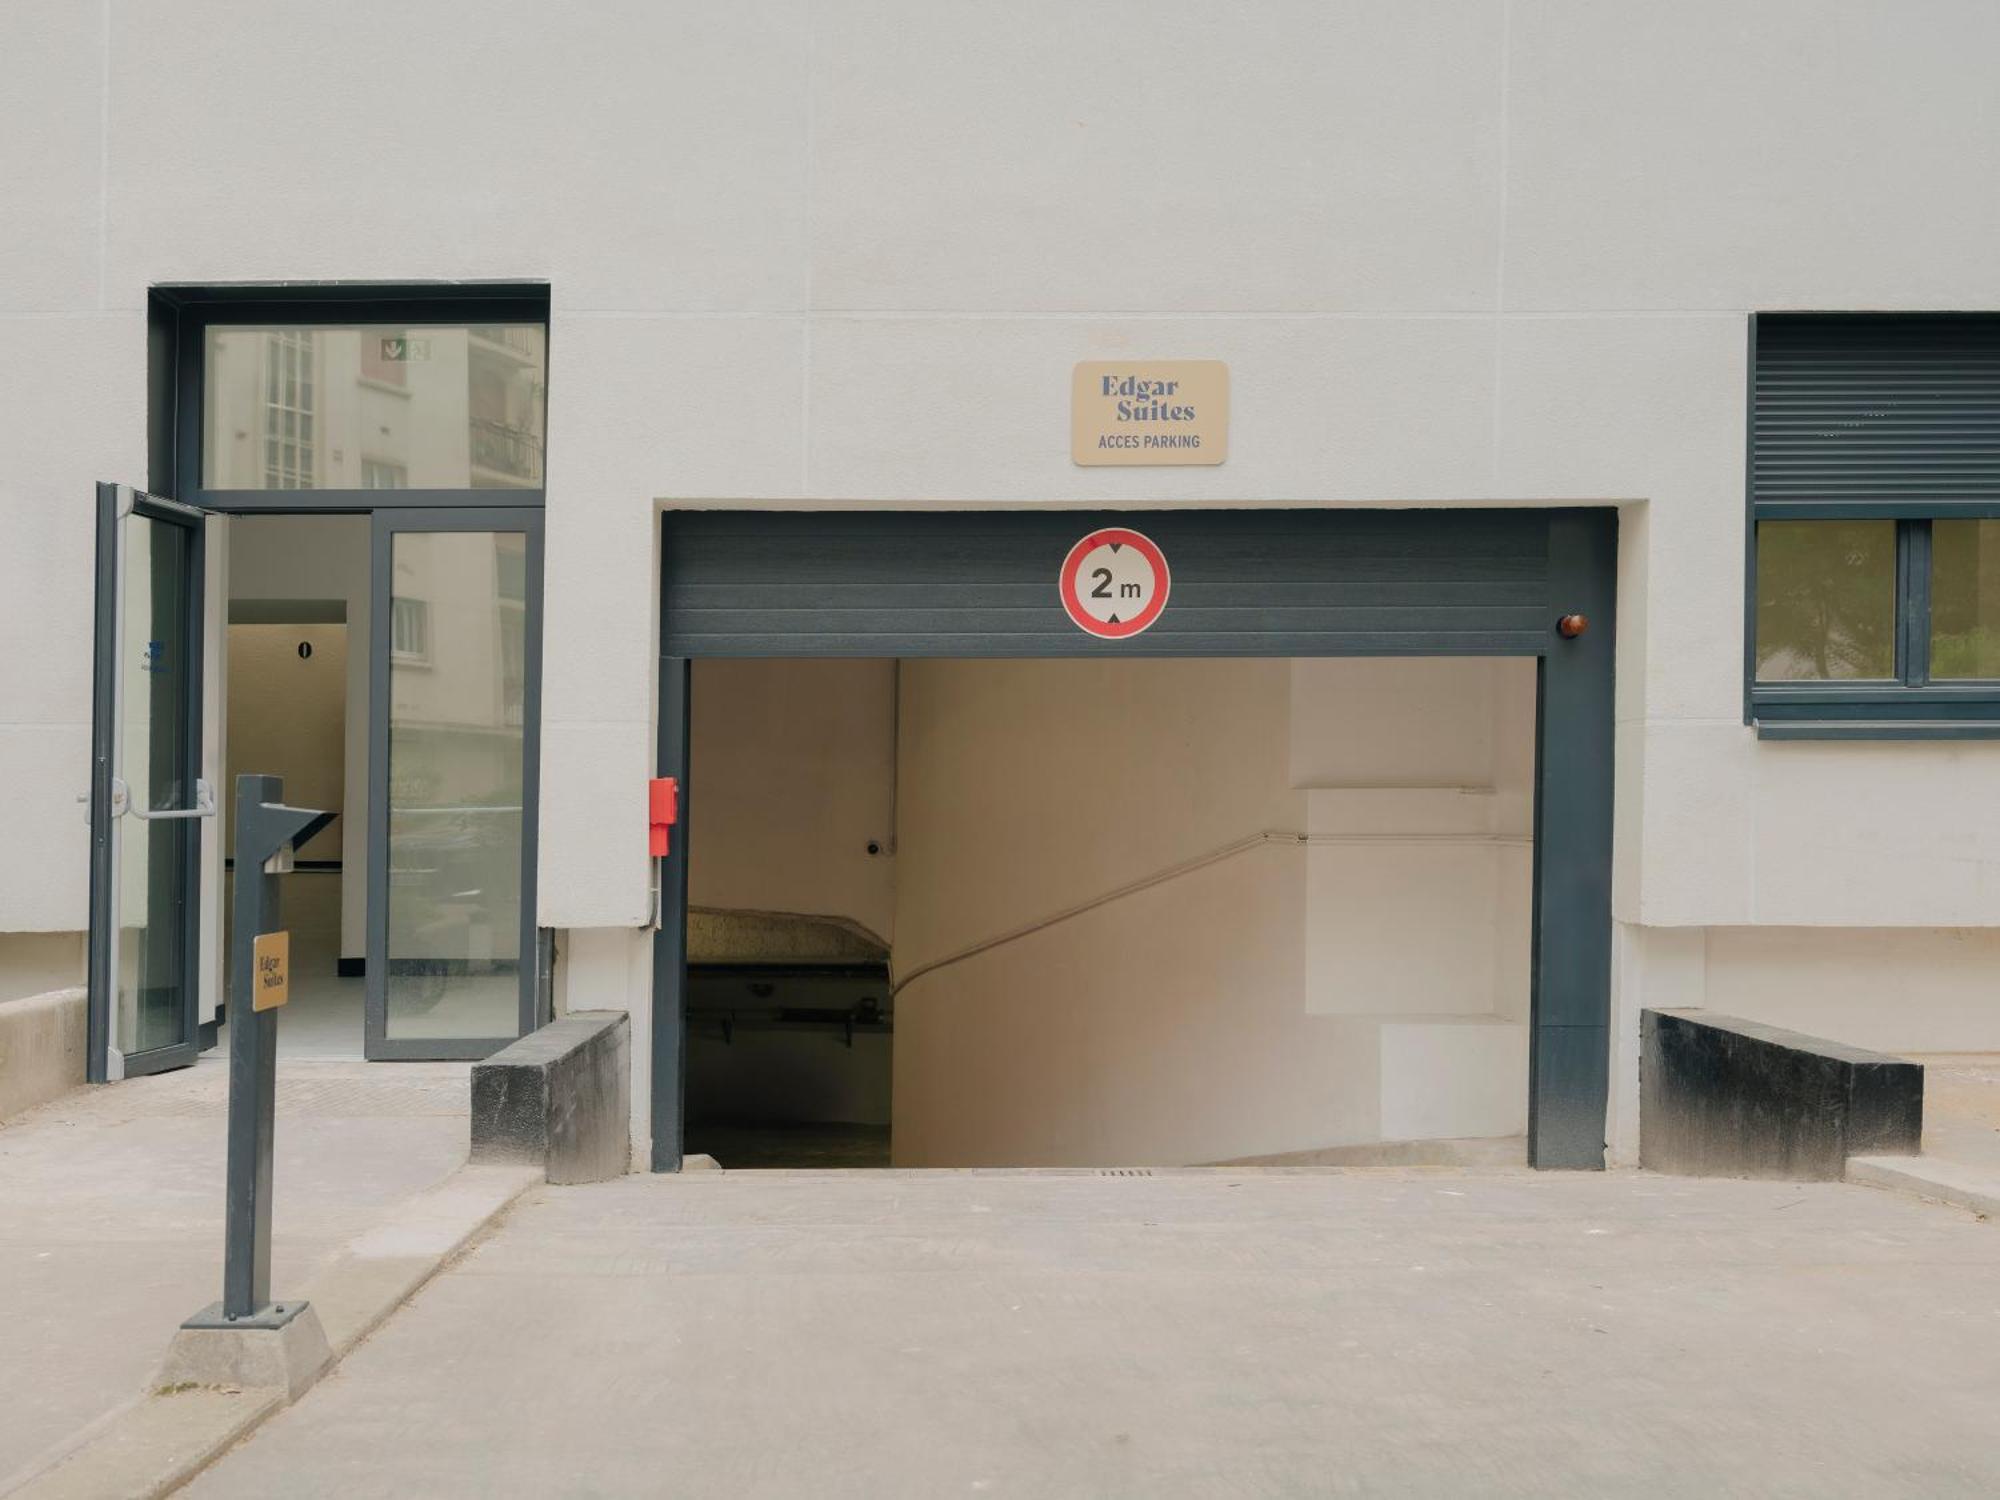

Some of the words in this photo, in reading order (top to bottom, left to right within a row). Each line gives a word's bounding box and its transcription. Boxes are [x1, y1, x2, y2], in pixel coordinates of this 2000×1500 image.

[1102, 375, 1179, 401] Edgar
[1117, 400, 1196, 422] Suites
[1098, 435, 1140, 449] ACCES
[1143, 435, 1201, 449] PARKING
[1091, 567, 1113, 598] 2
[1120, 582, 1141, 598] m
